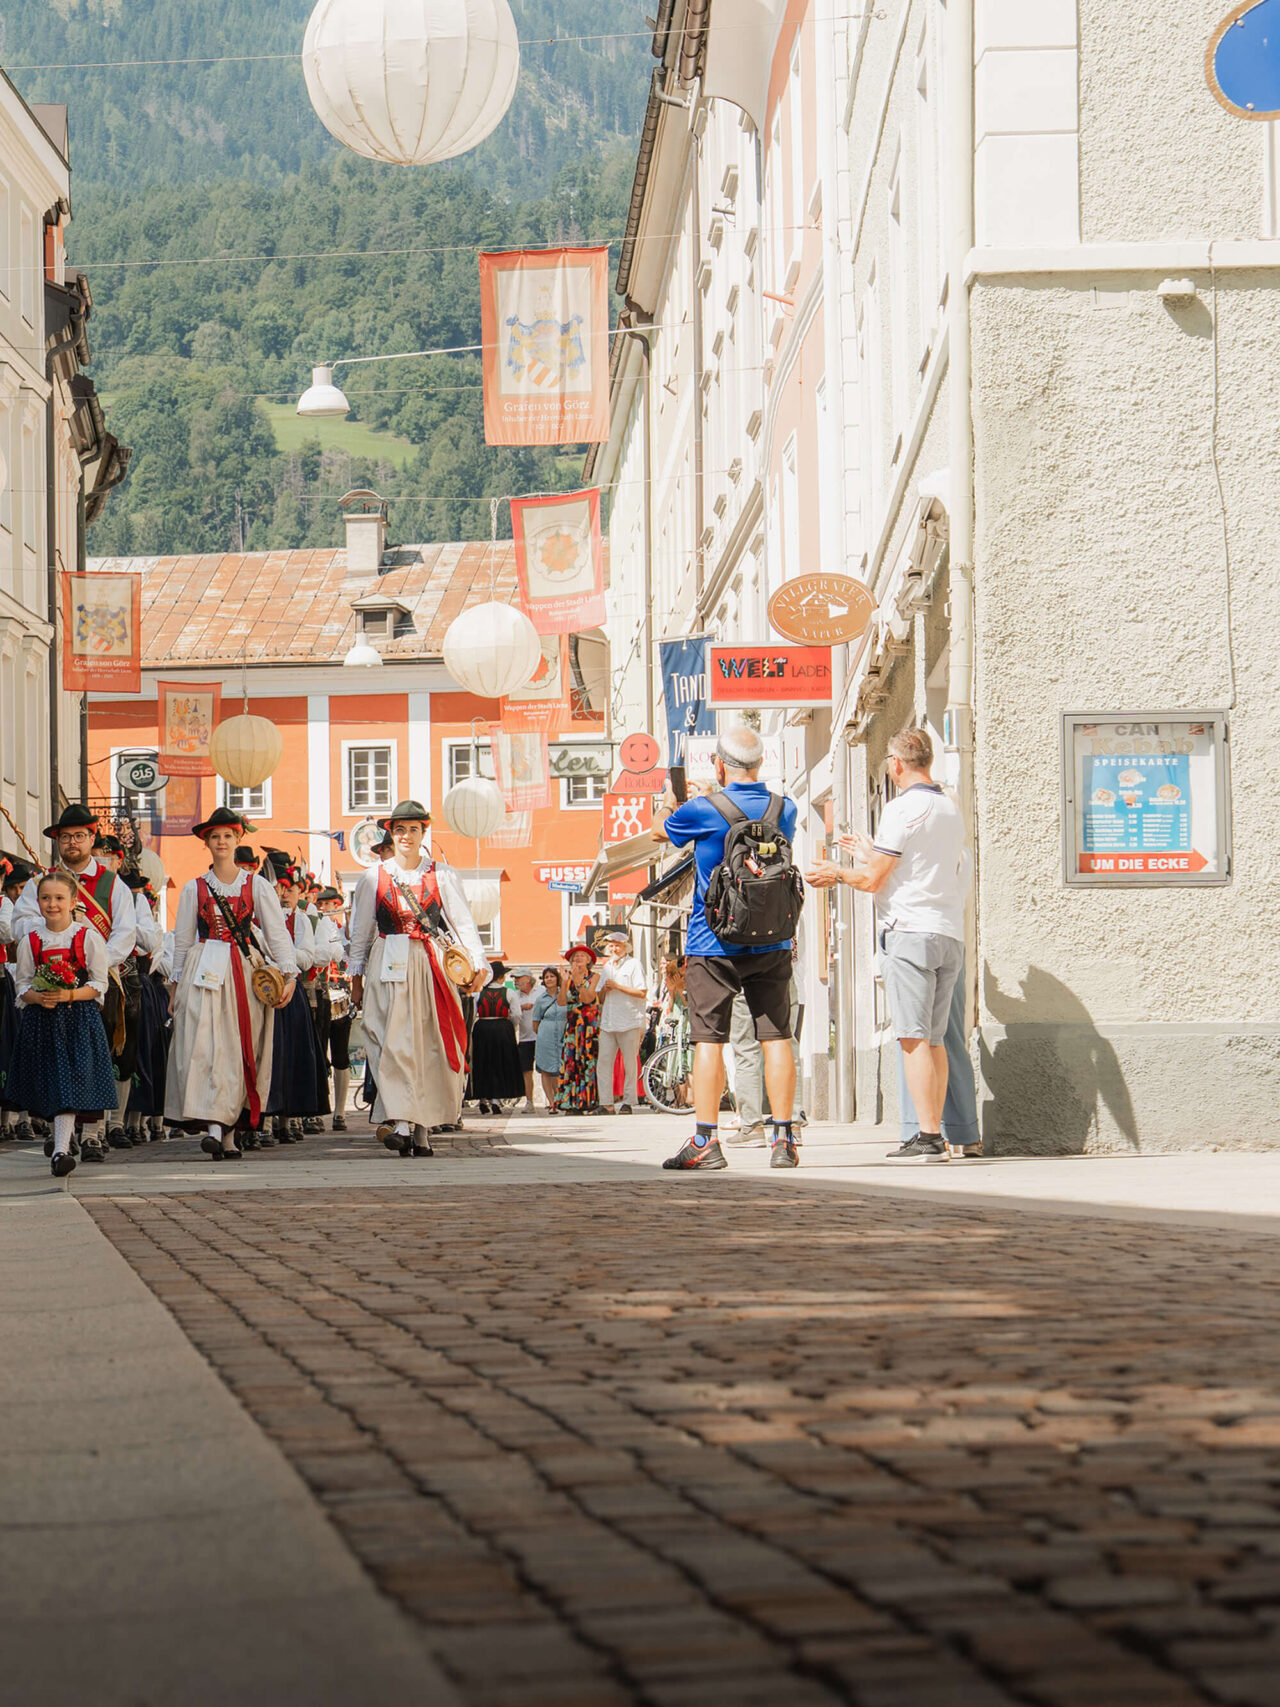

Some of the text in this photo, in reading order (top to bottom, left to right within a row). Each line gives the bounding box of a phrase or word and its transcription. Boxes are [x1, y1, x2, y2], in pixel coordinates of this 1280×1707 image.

[503, 400, 590, 412] Grafen von Görz
[801, 627, 844, 639] NATUR
[718, 657, 788, 679] WELT
[670, 672, 707, 708] TAND
[684, 705, 697, 727] &
[1091, 737, 1194, 755] Kebab
[1094, 758, 1179, 767] SPEISEKARTE
[131, 765, 153, 780] eis
[1090, 857, 1189, 870] UM DIE ECKE
